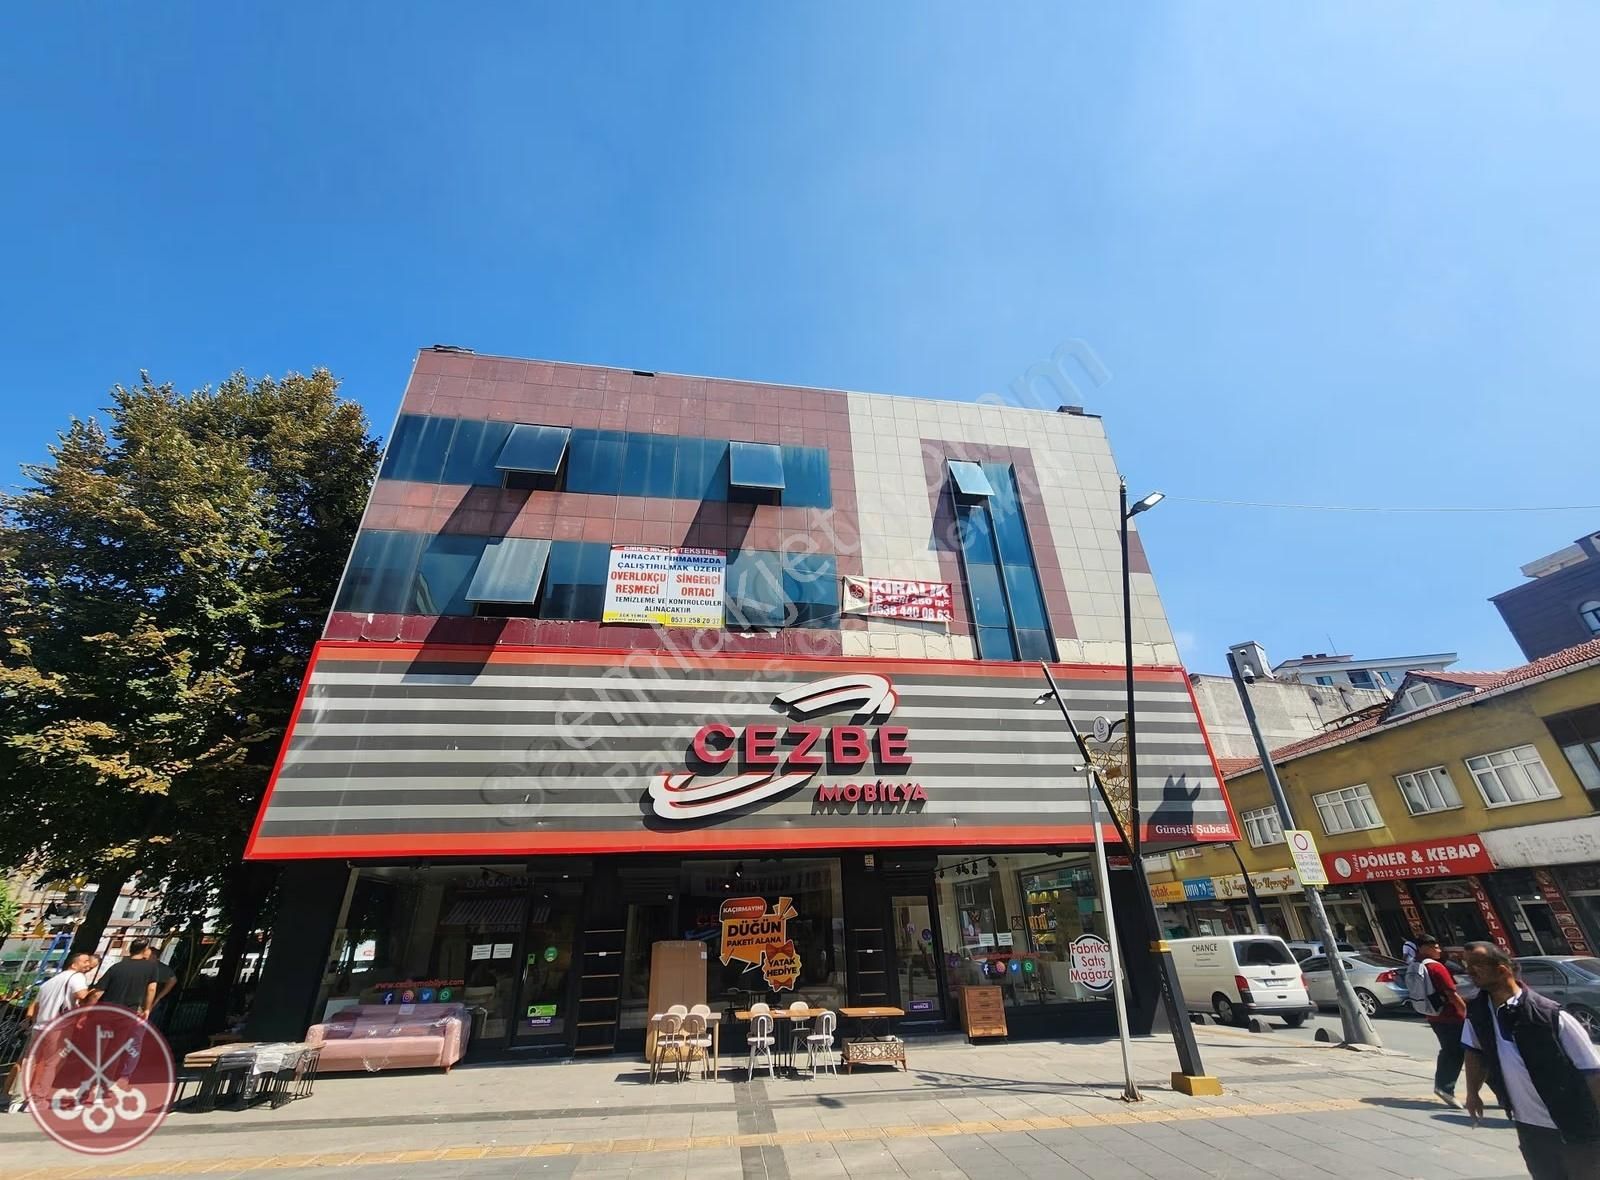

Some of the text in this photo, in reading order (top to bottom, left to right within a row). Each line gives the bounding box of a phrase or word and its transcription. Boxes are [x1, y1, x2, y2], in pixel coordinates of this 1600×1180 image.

[610, 571, 667, 583] OVERLOKÇU
[615, 583, 715, 597] REŞMECİ ORTACI
[870, 579, 951, 598] KIRALIK
[693, 723, 913, 765] CEZBE
[818, 778, 929, 803] MOBİLYA
[1155, 823, 1231, 837] Güneşli Şubesi
[1359, 843, 1481, 869] DÖNER & KEBAP
[1375, 865, 1436, 878] 0212 657 30 37
[727, 919, 782, 937] DÜĞÜN
[726, 936, 782, 947] PAKETİ ALANA
[1070, 942, 1110, 954] Fabrika
[1191, 943, 1218, 953] CHANCE
[768, 957, 796, 967] YATAK
[1081, 955, 1106, 968] Satış
[766, 966, 797, 977] HEDİYE
